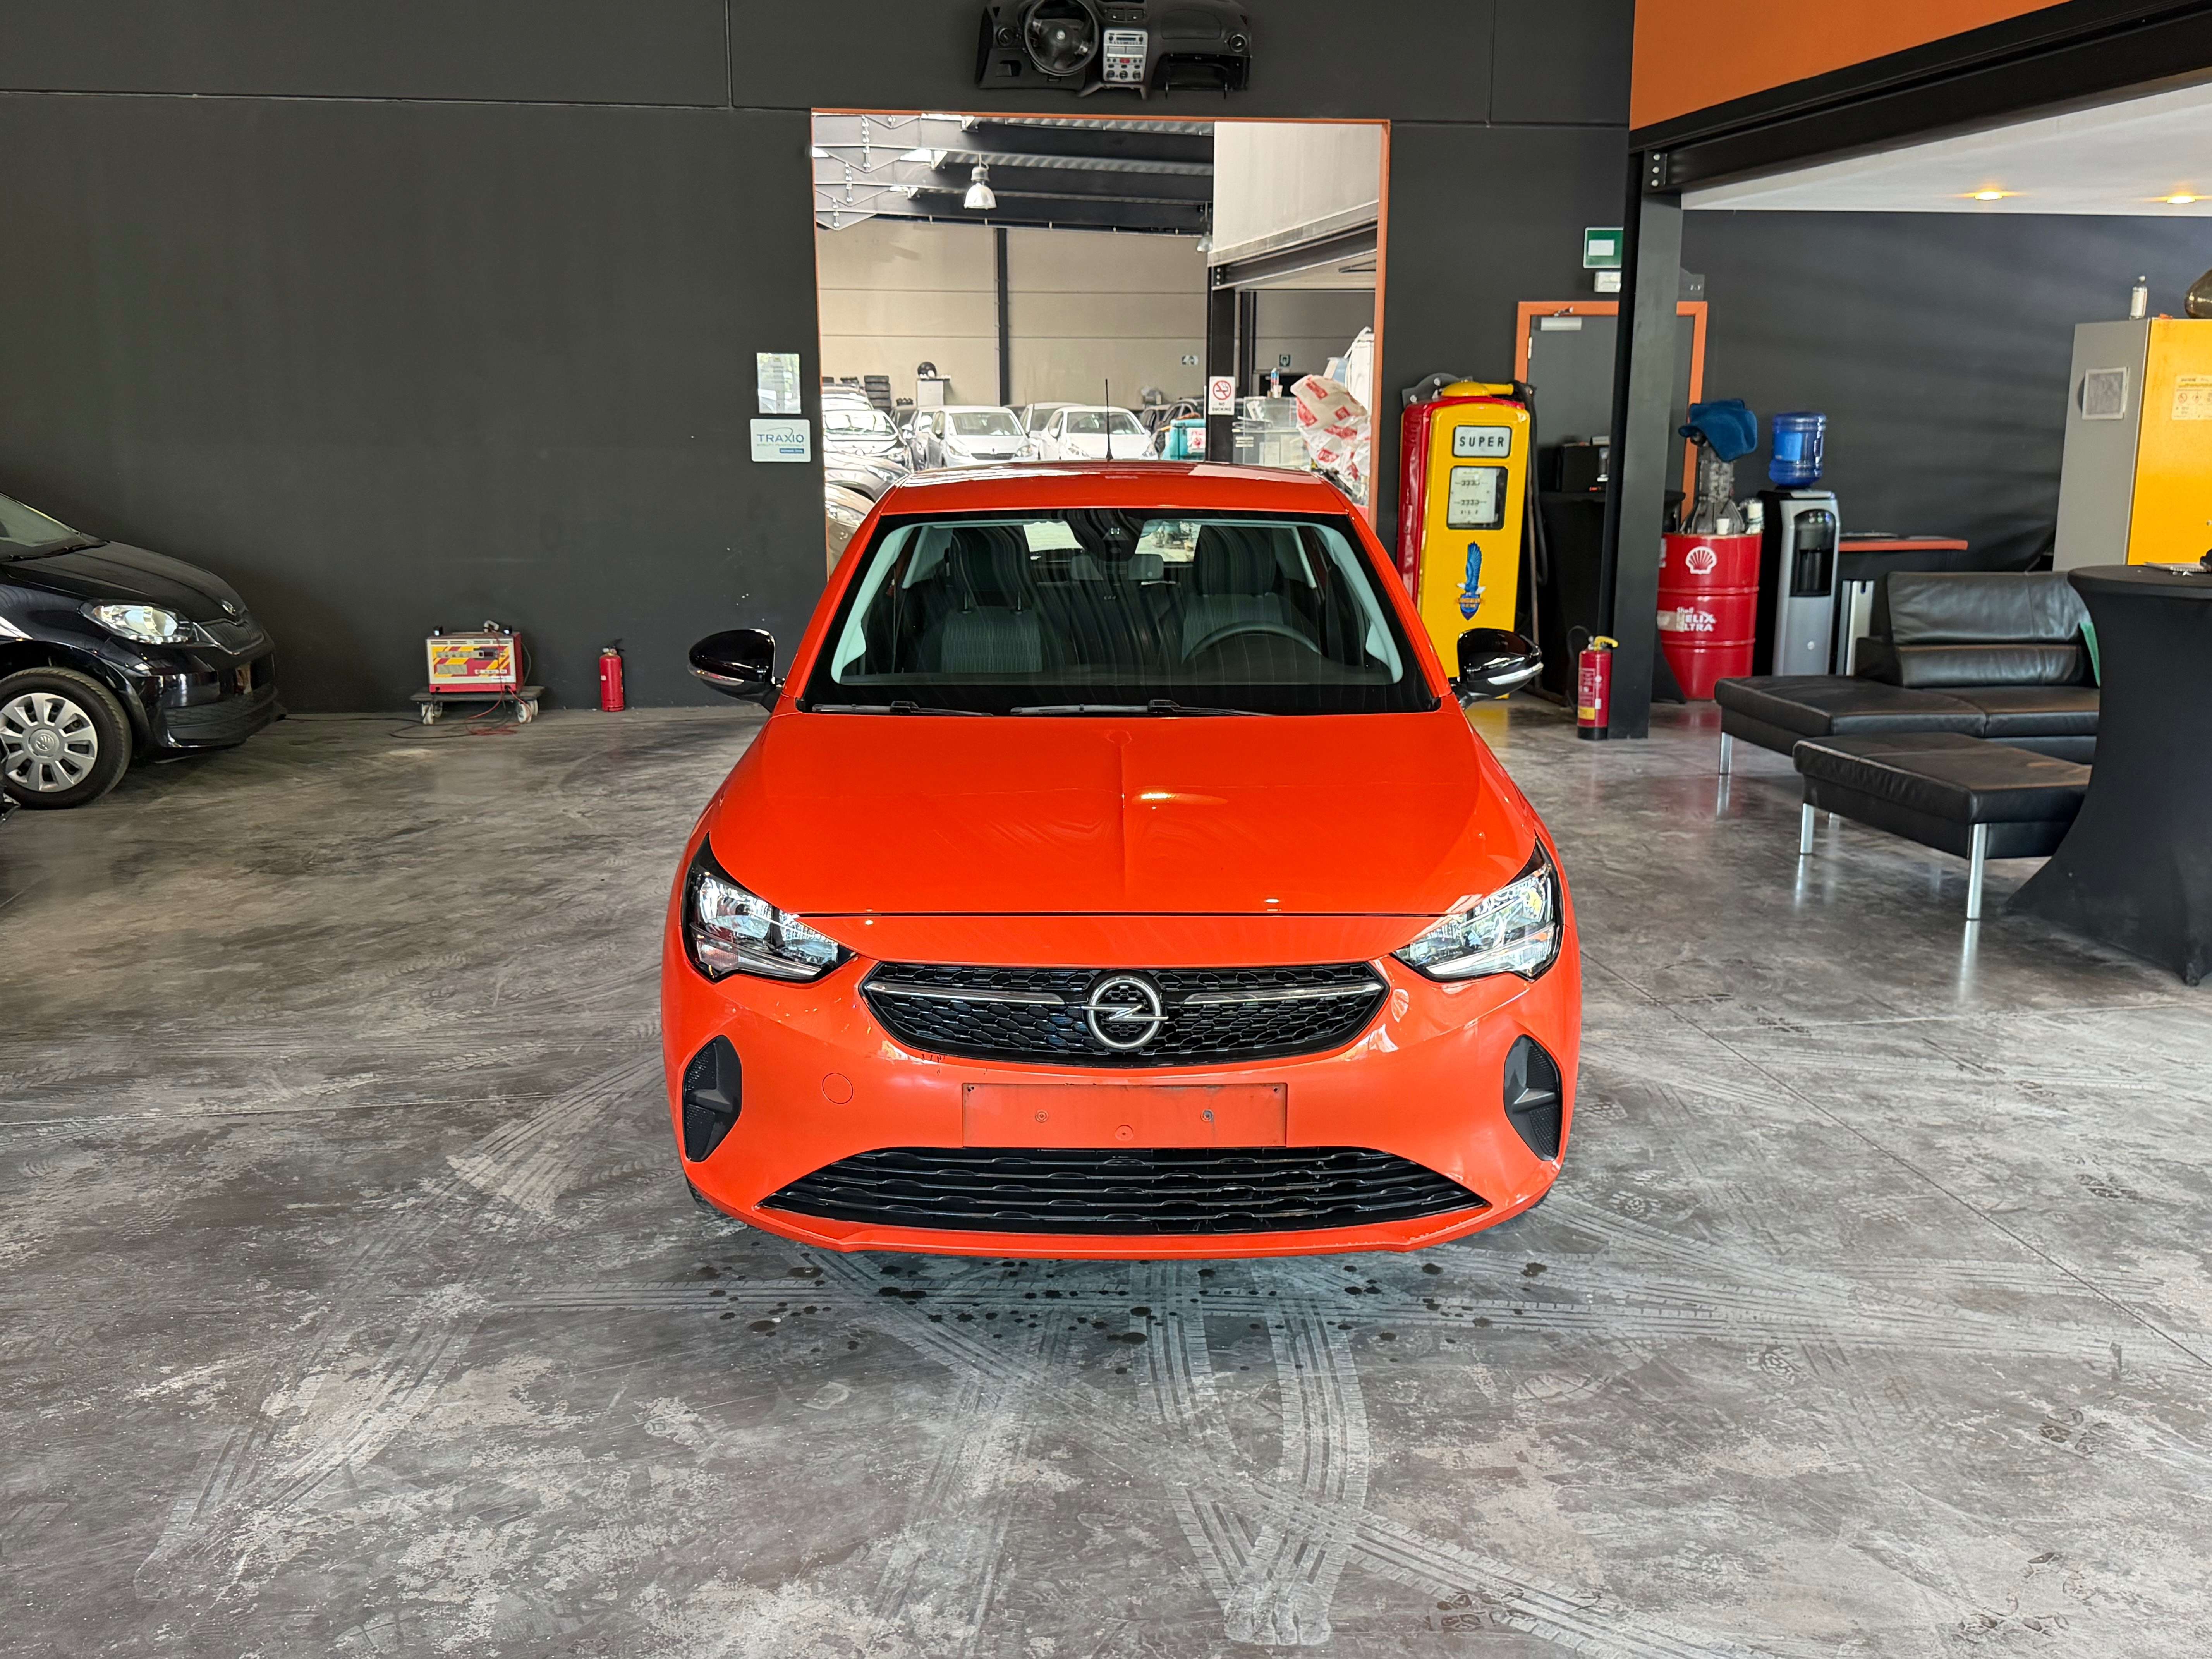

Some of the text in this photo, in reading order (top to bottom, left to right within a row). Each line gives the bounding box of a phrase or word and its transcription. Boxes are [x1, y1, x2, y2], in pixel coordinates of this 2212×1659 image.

[757, 433, 804, 443] TRAXIO
[1460, 436, 1504, 447] SUPER
[1685, 612, 1716, 623] ELIX
[1684, 623, 1713, 632] LTRA
